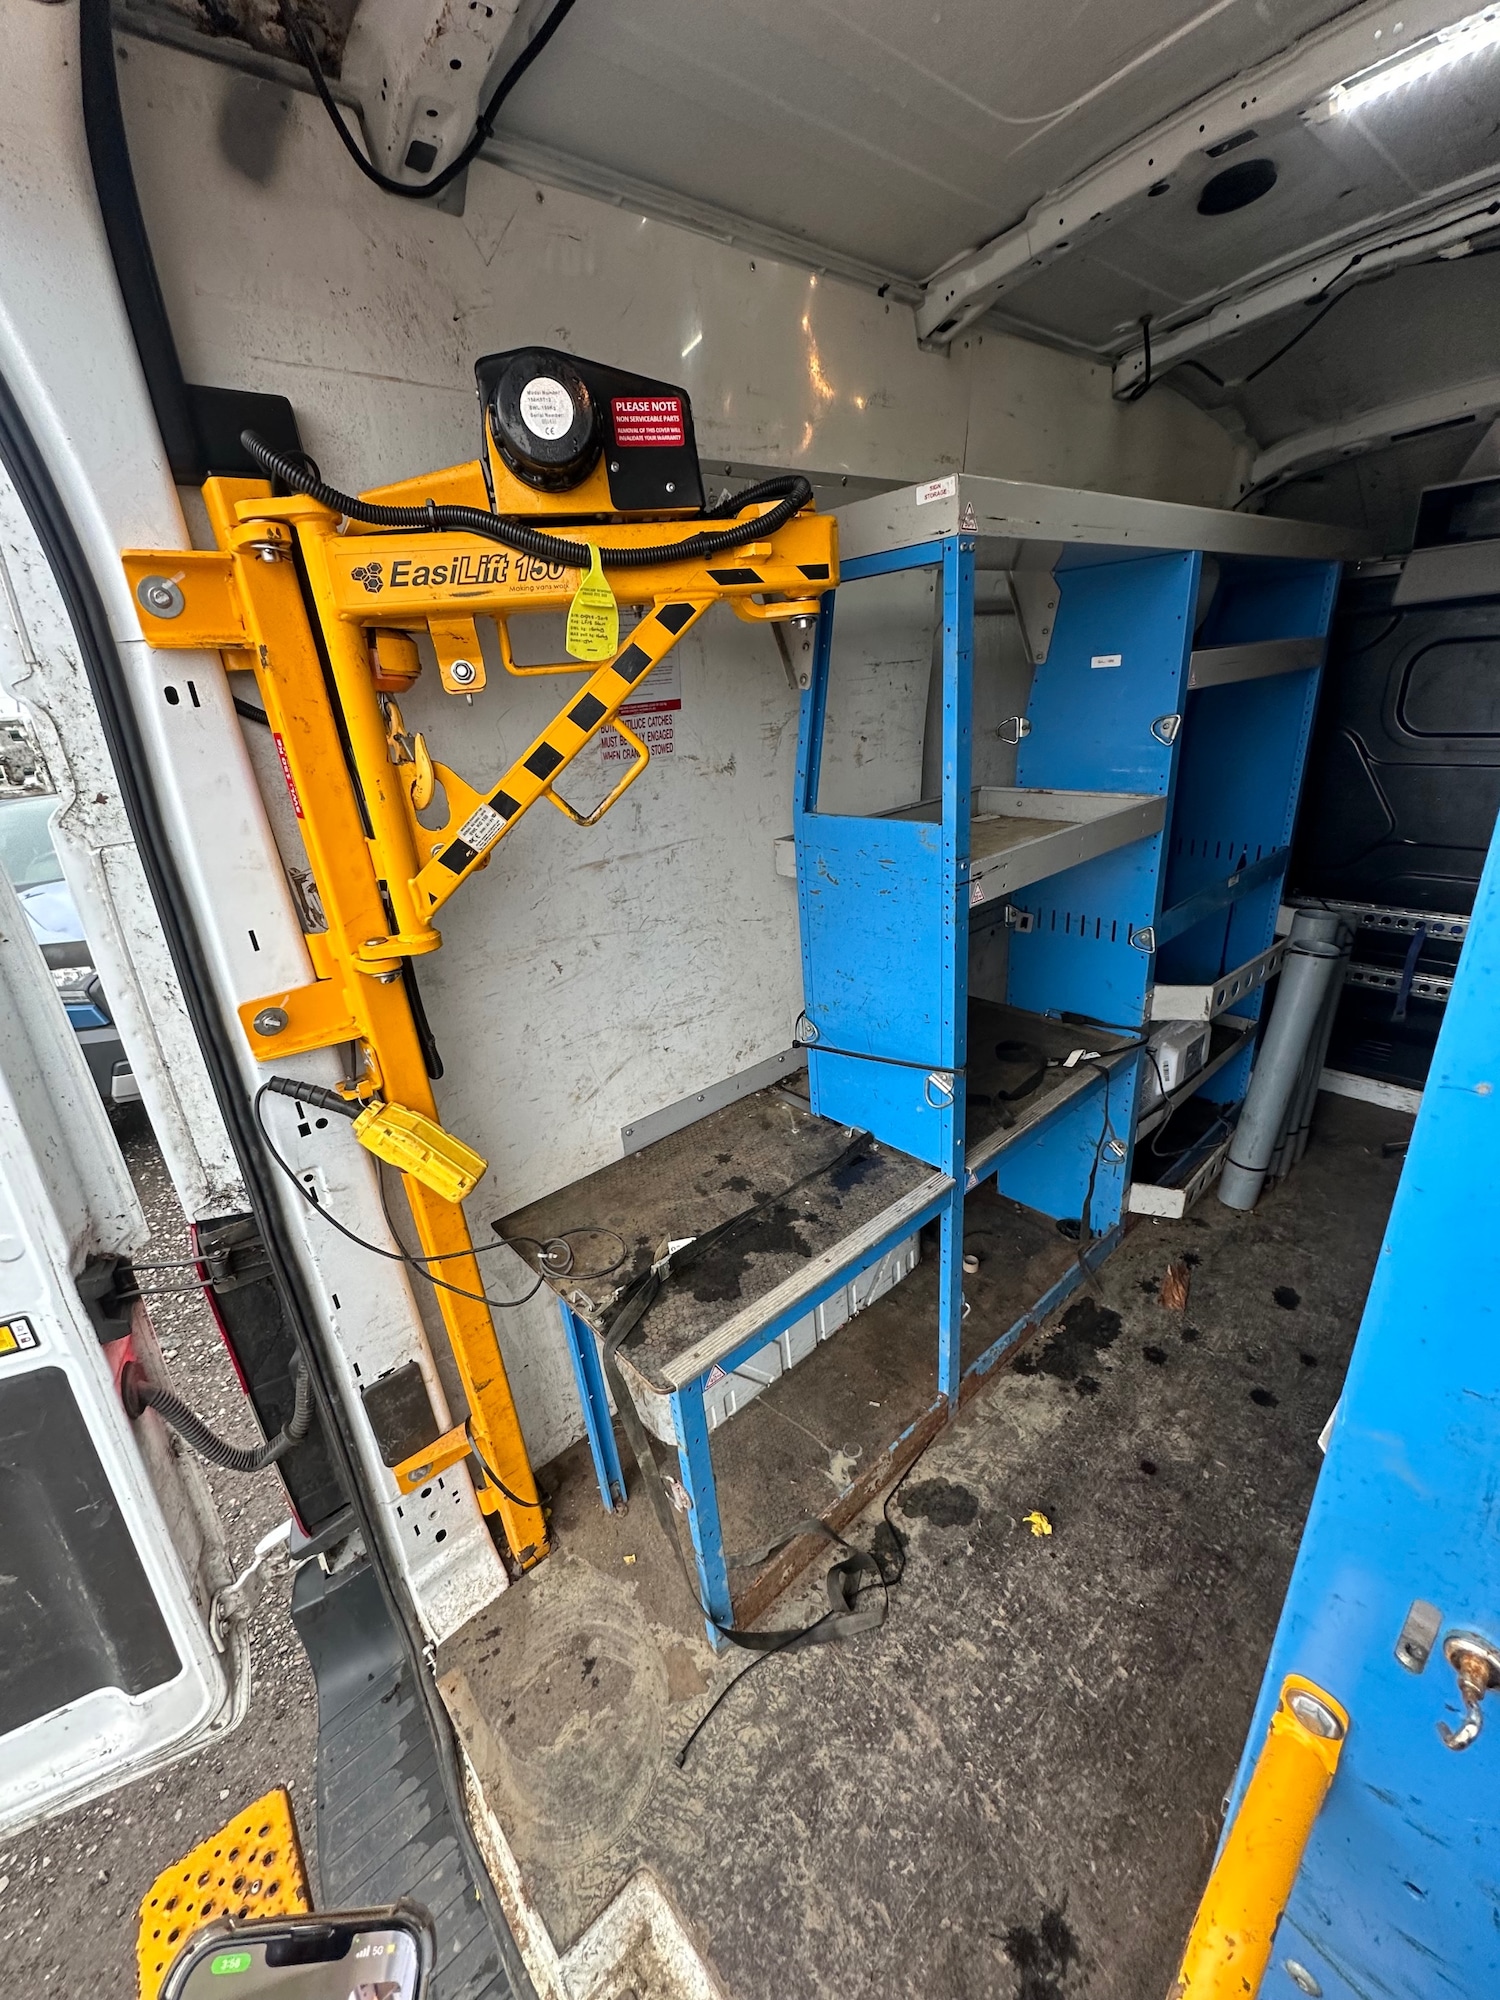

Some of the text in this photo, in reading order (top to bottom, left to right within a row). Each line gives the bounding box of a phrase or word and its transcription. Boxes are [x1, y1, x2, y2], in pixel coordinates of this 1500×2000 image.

[615, 401, 678, 412] PLEASE NOTE
[615, 414, 680, 423] NON SERVICEABLE PARTS
[618, 434, 644, 442] INVALIDATE
[929, 483, 941, 491] SIGN
[924, 488, 947, 501] STORAGE
[390, 552, 567, 588] EasiLift 150
[508, 584, 535, 593] Making
[536, 583, 552, 592] vans
[647, 714, 673, 728] CATCHES
[601, 735, 618, 749] MUST
[647, 728, 674, 742] ENGAGED
[602, 750, 621, 760] WHEN
[651, 742, 674, 756] STOWED
